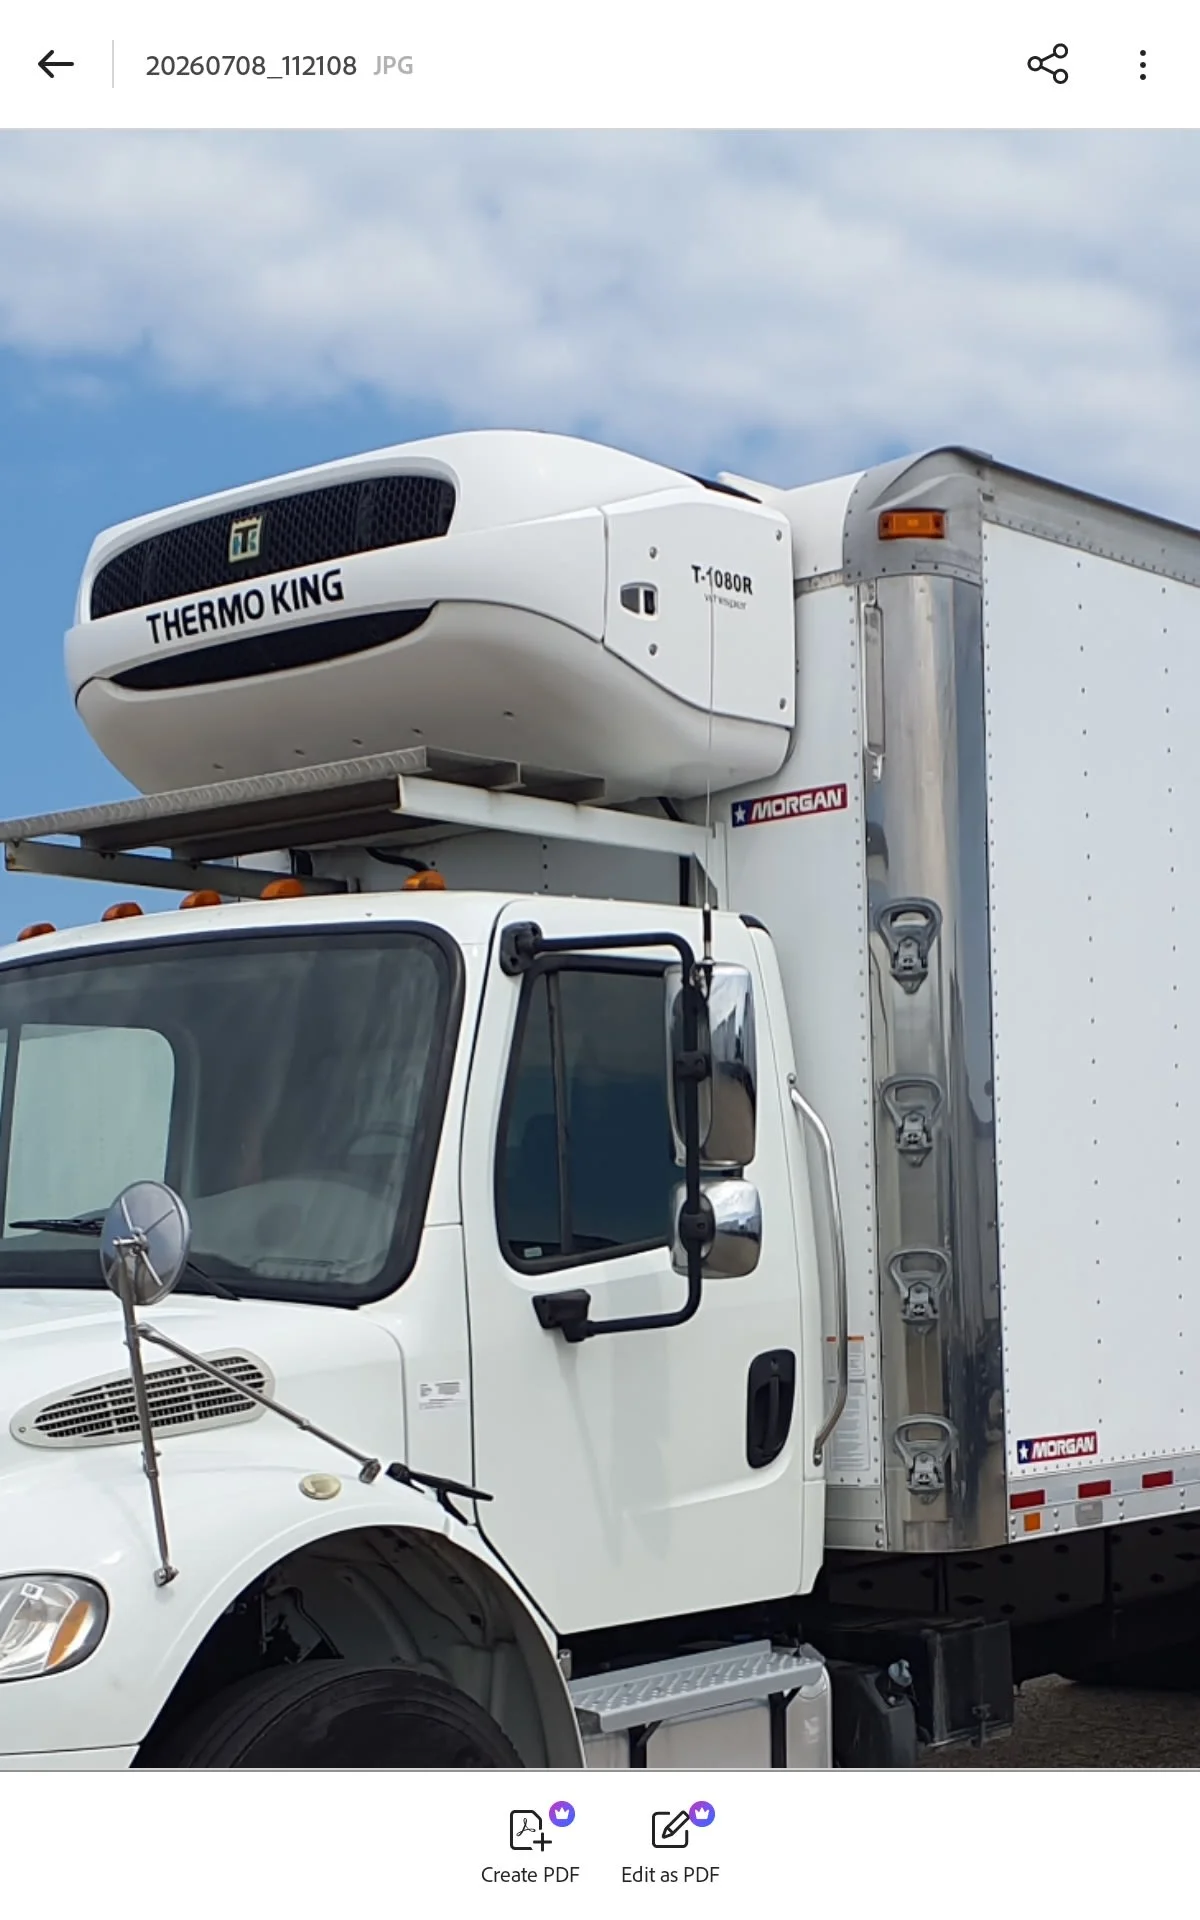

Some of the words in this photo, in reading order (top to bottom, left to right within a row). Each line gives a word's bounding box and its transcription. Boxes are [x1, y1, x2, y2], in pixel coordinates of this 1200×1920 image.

[691, 564, 753, 595] T-1080R
[146, 589, 265, 644] THERMO
[271, 568, 344, 615] KING
[751, 787, 842, 821] MORGAN
[1031, 1434, 1095, 1460] MORGAN
